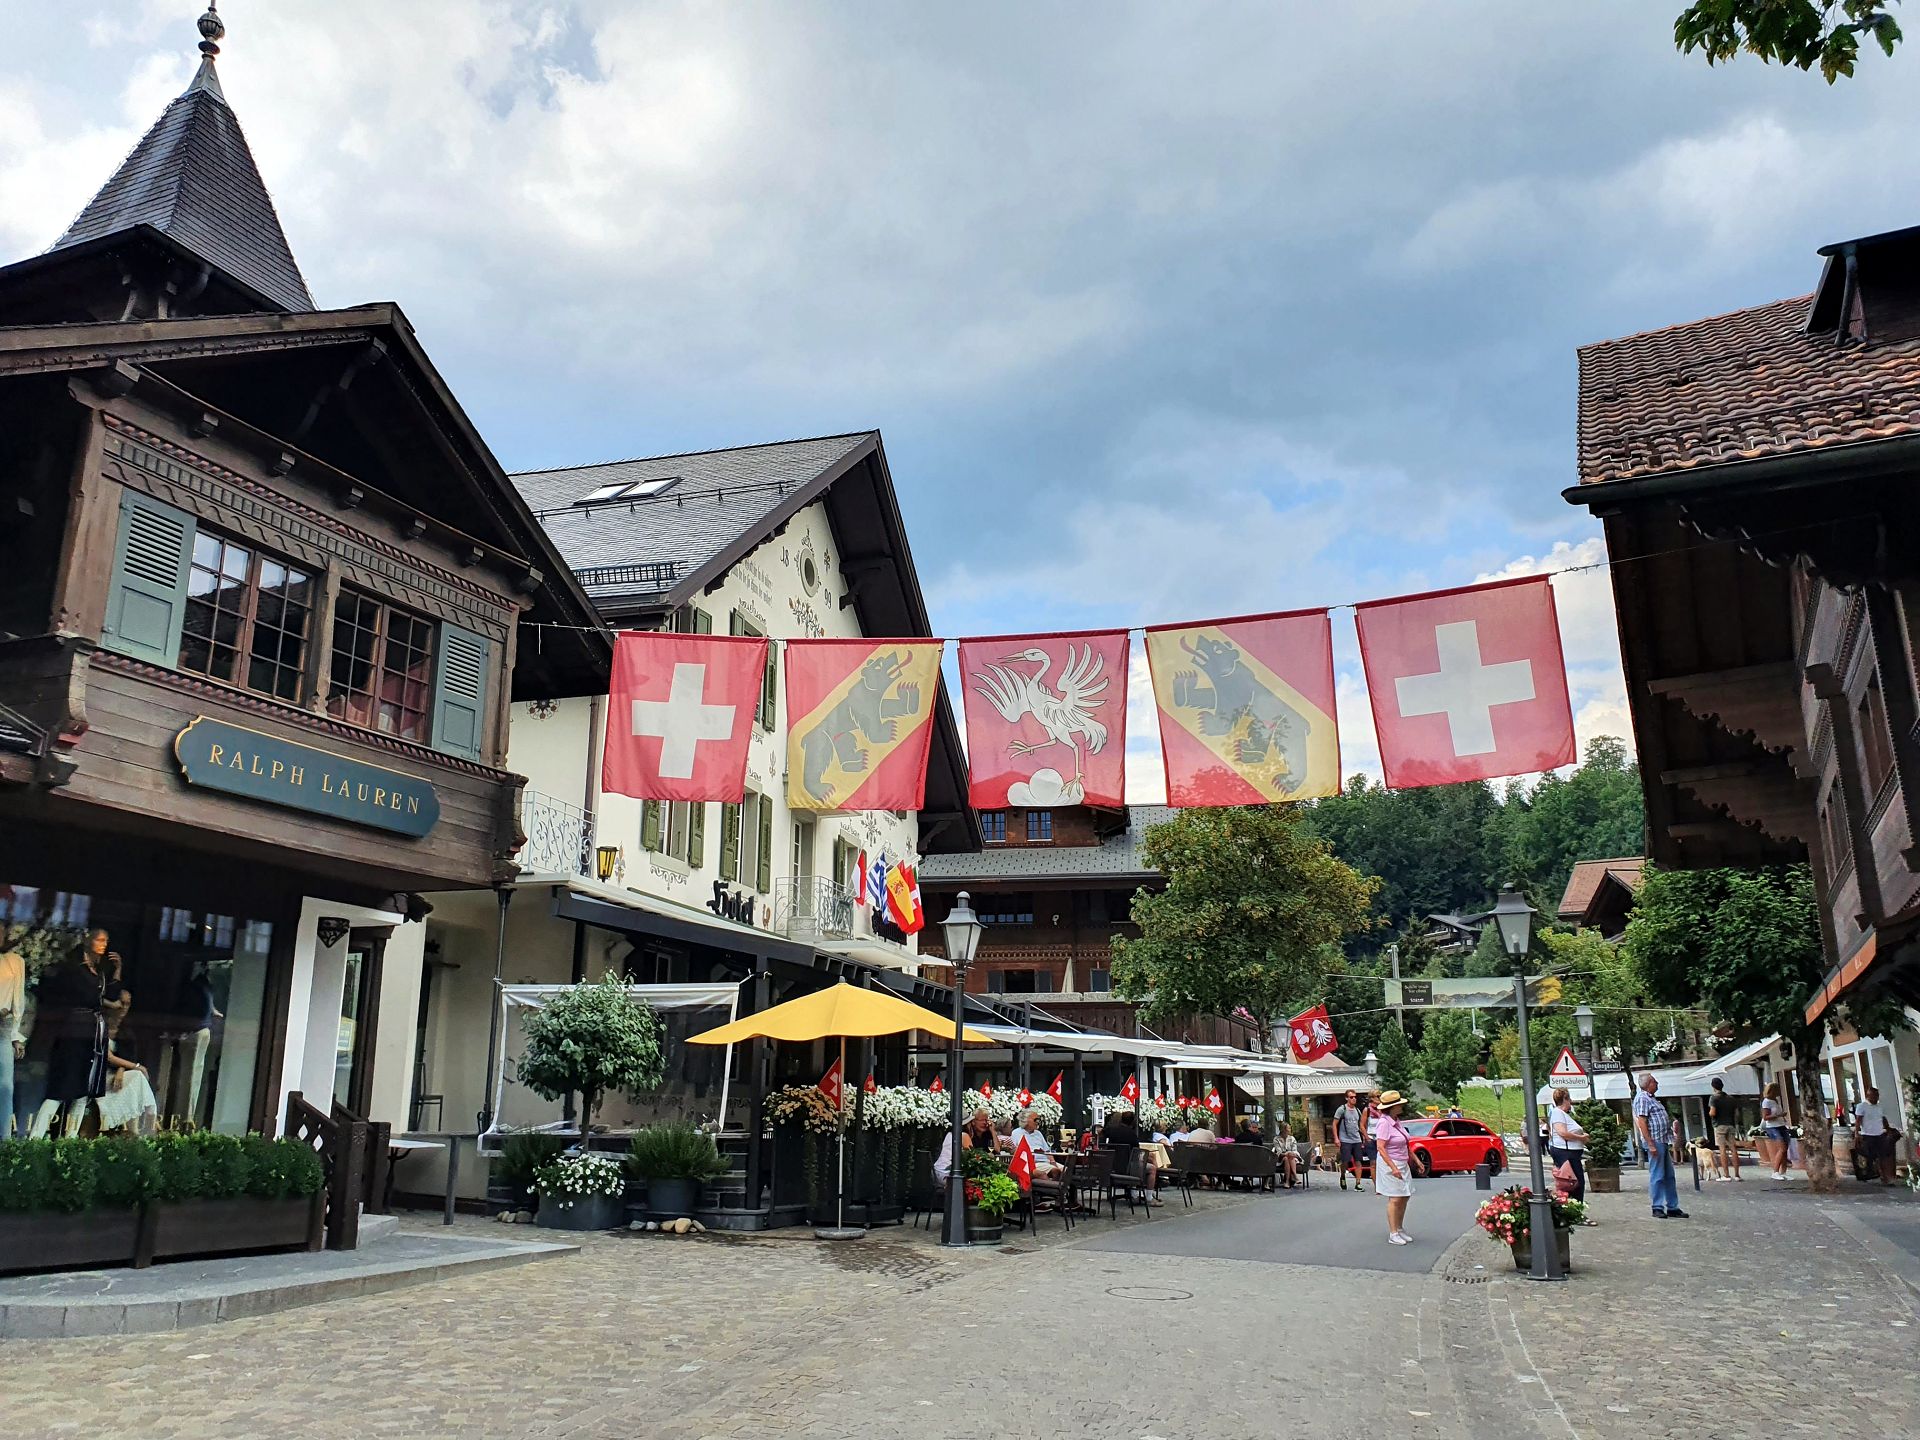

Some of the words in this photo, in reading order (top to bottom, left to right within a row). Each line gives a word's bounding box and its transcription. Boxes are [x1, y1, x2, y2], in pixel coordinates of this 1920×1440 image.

[208, 743, 304, 785] RALPH
[322, 773, 420, 815] LAUREN
[1551, 1077, 1586, 1085] Senksäulen
